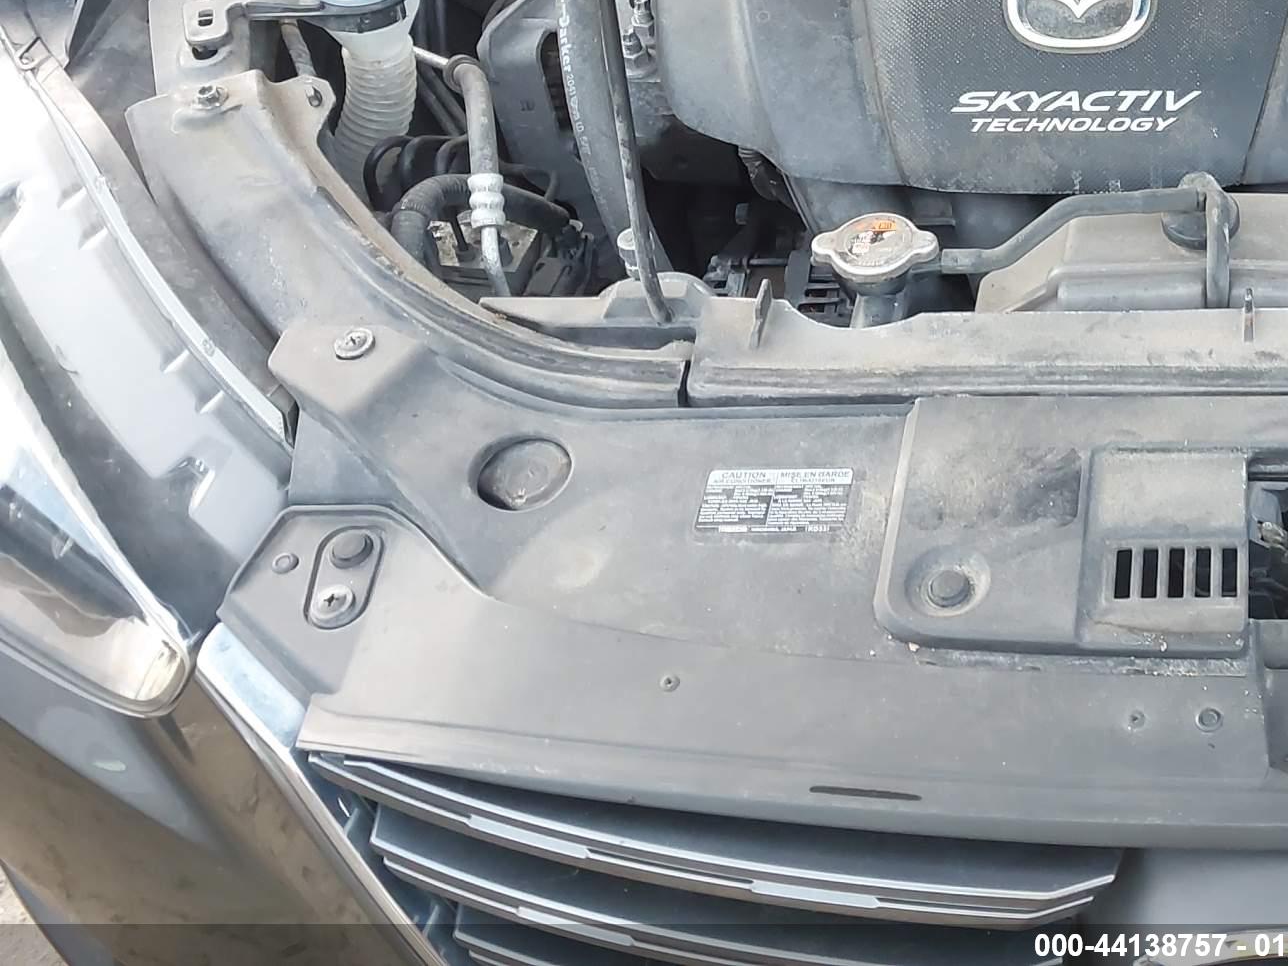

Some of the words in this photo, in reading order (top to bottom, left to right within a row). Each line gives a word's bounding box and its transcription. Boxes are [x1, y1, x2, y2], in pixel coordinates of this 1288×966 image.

[950, 90, 1202, 113] SKYACTIV
[970, 117, 1178, 133] TECHNOLOGY
[721, 471, 767, 479] CAUTION
